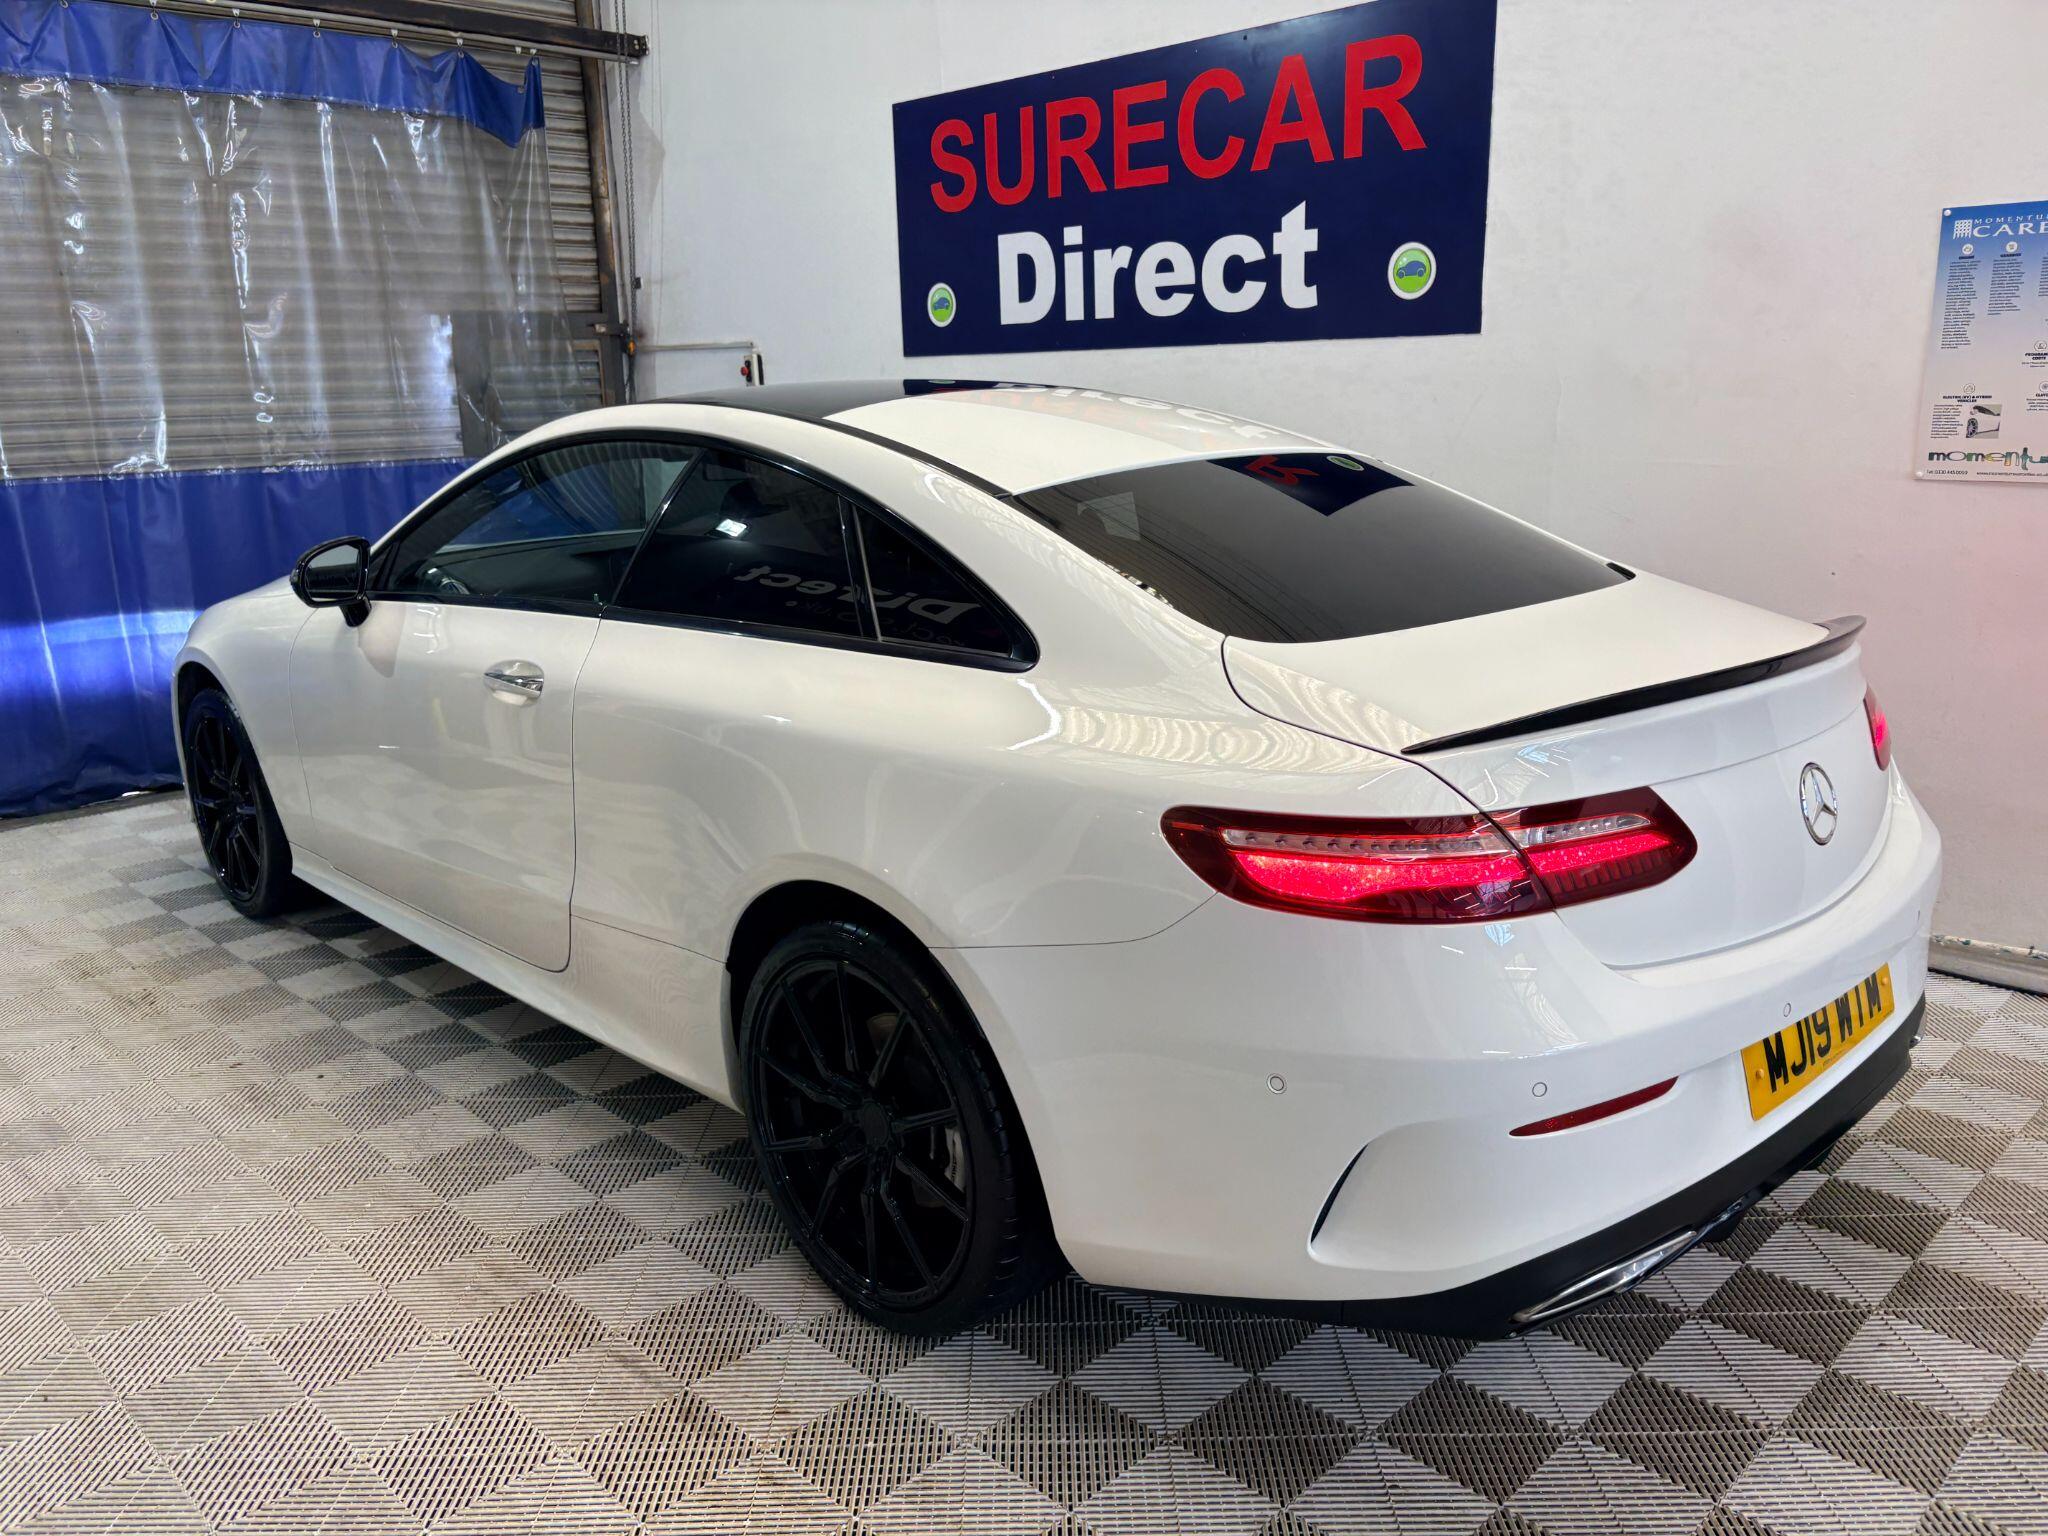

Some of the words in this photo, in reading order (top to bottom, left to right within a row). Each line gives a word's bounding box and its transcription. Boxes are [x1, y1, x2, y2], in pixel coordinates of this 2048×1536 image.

[930, 34, 1428, 213] SURECAR
[1974, 213, 2048, 225] MOMENTU
[997, 200, 1319, 326] Direct
[1928, 447, 2048, 471] momentu
